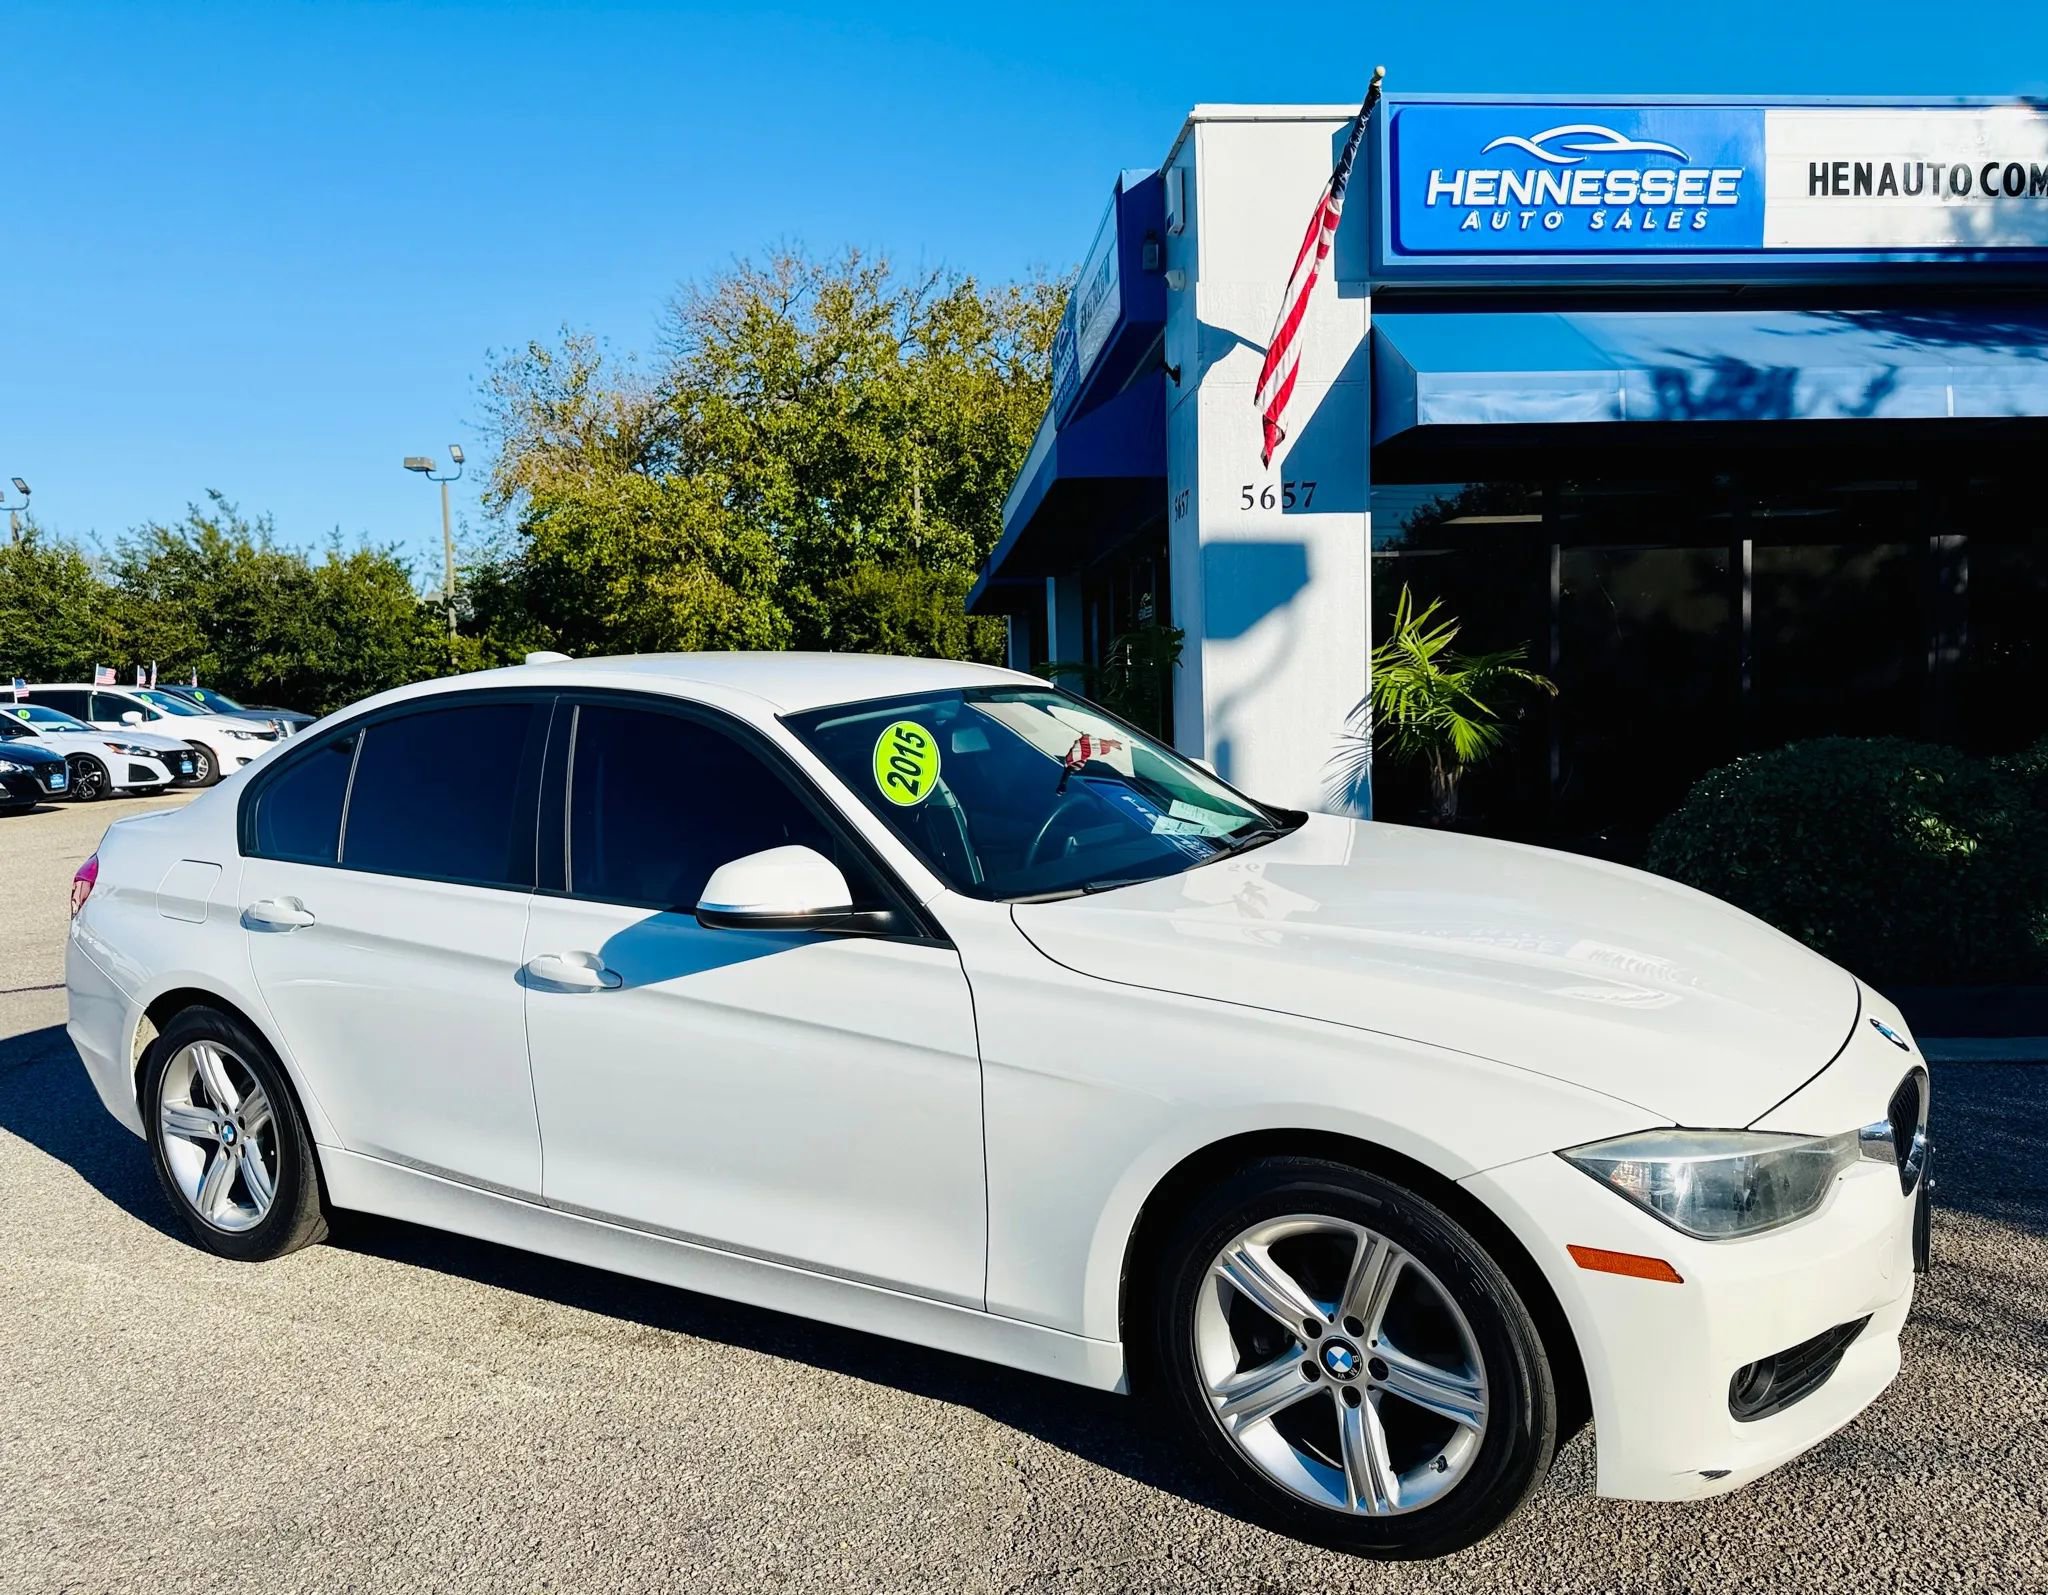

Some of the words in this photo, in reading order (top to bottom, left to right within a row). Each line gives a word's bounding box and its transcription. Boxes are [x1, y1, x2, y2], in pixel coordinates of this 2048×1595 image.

[1427, 168, 1744, 206] HENNESSEE
[1462, 209, 1564, 230] AUTO
[1590, 209, 1708, 230] SALES
[1174, 489, 1190, 523] 5657
[1240, 481, 1318, 511] 5657
[886, 726, 926, 798] 2015
